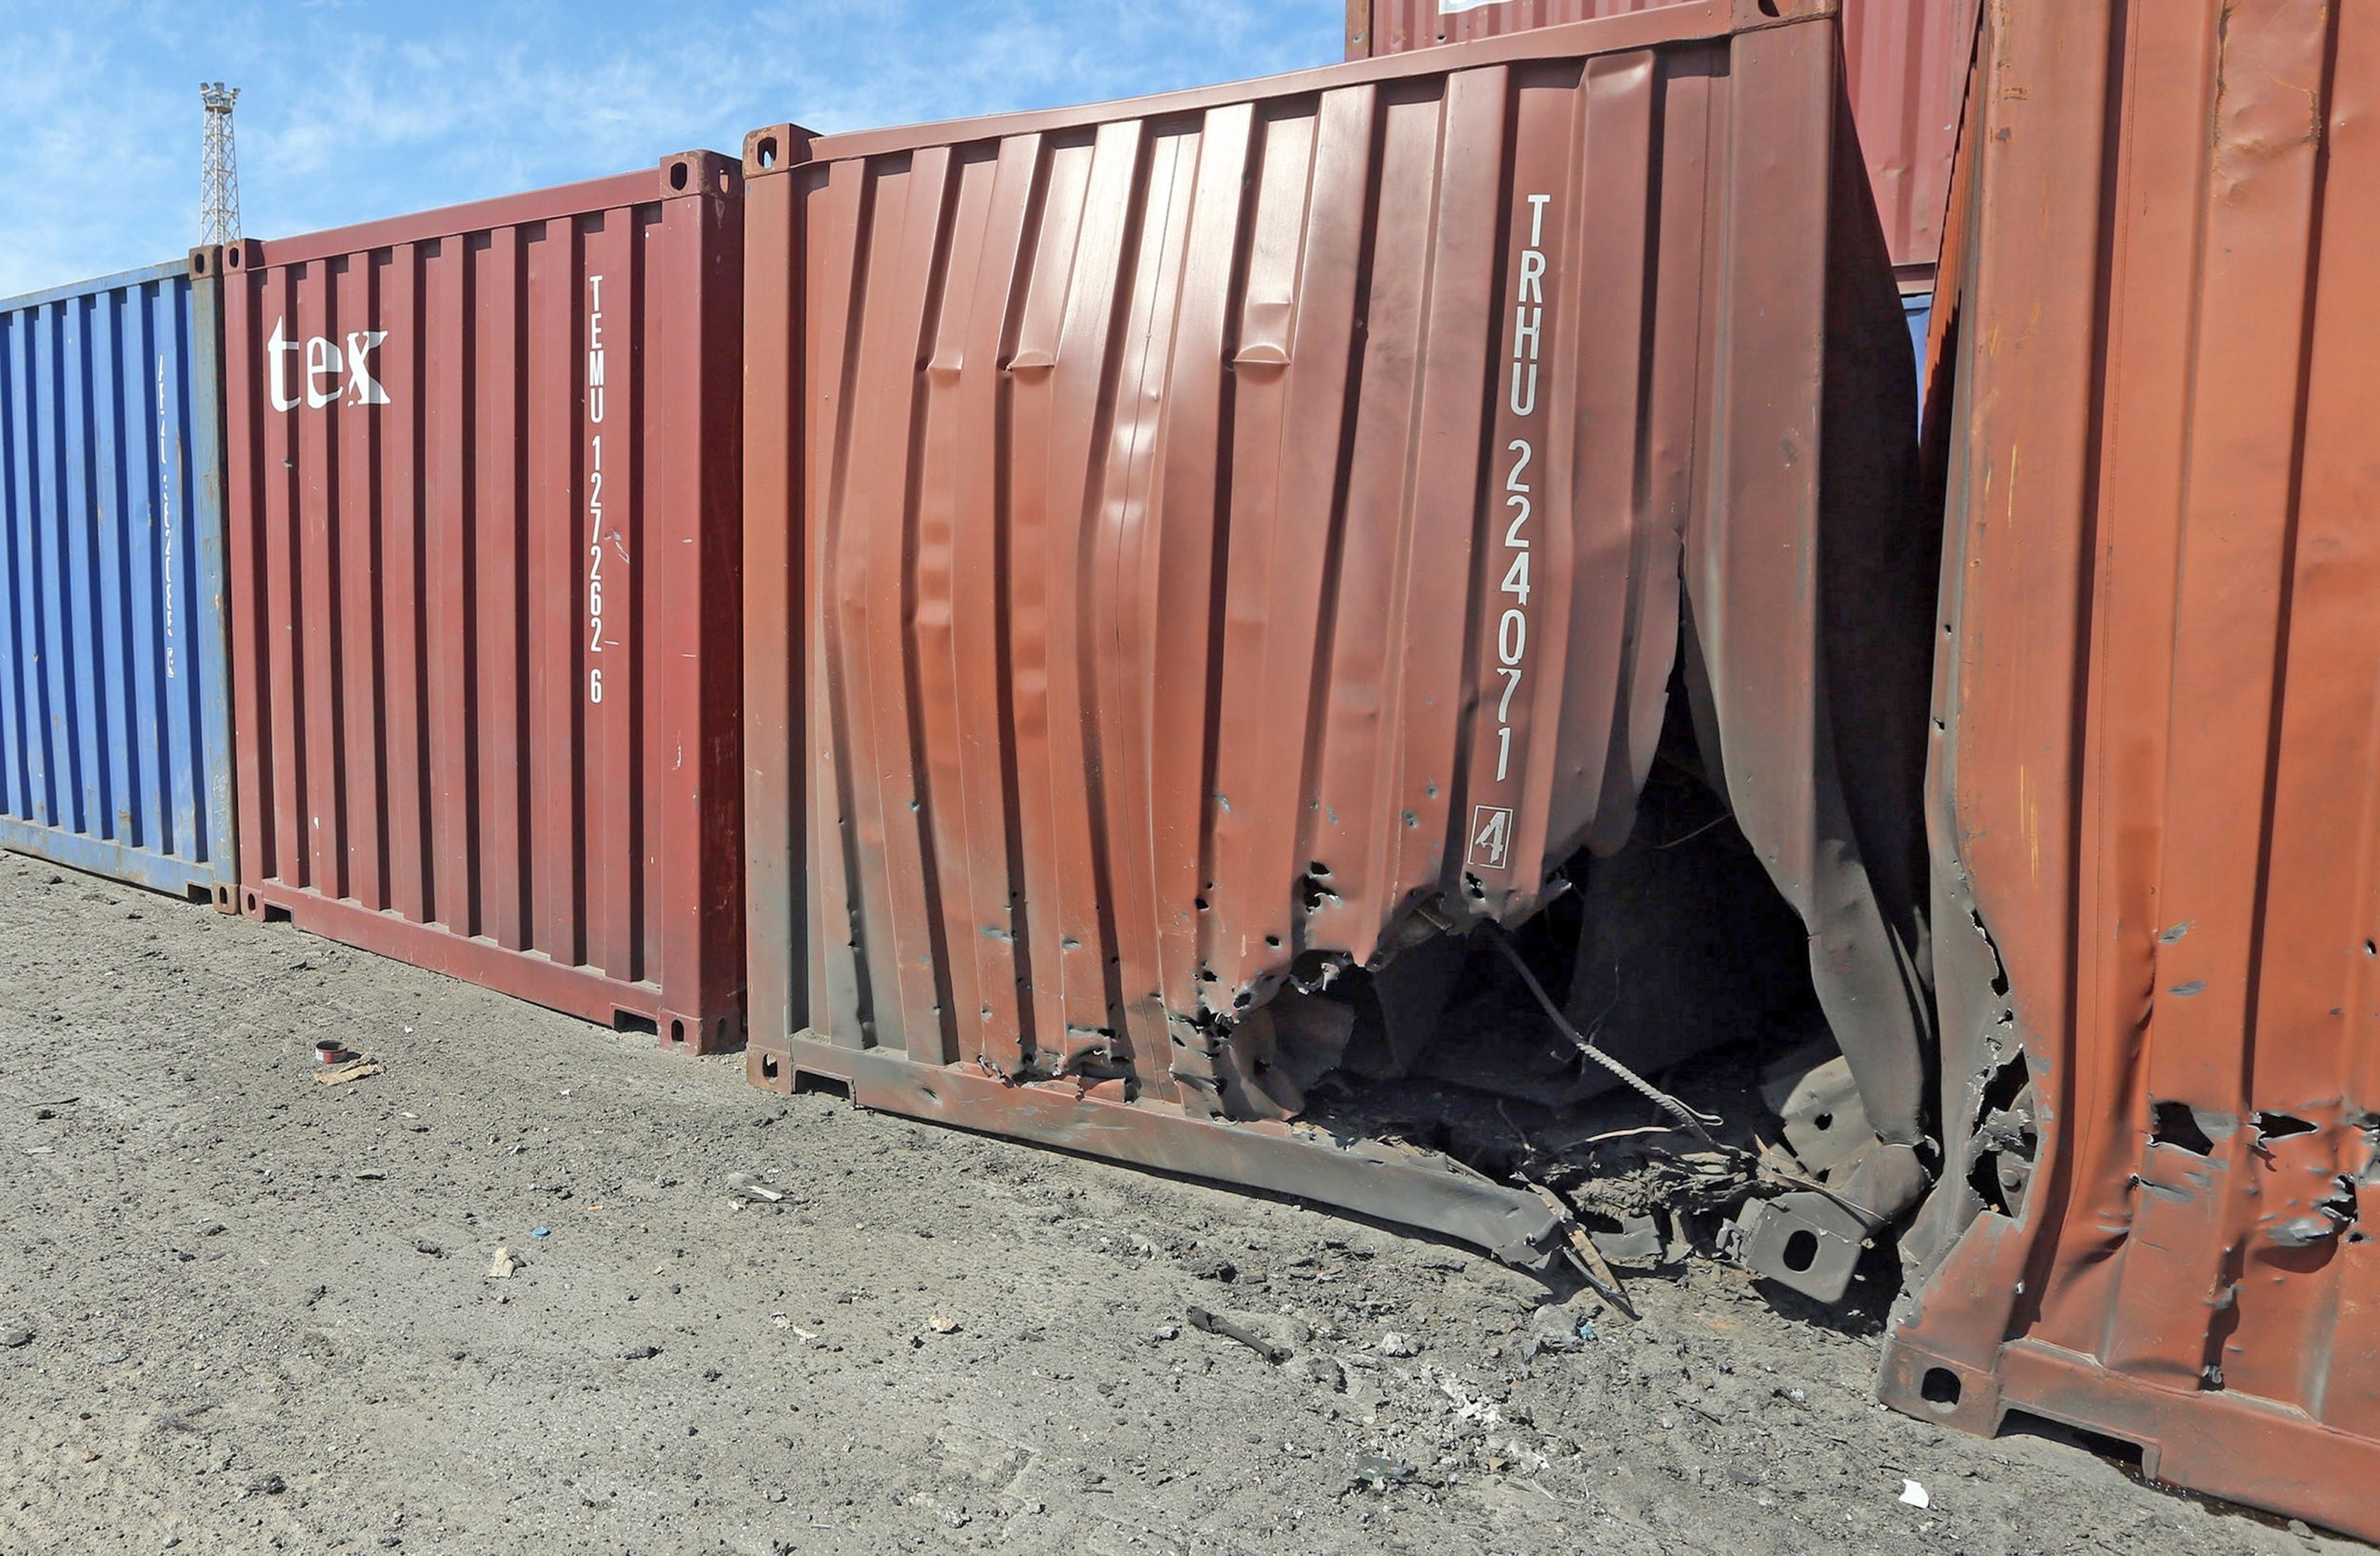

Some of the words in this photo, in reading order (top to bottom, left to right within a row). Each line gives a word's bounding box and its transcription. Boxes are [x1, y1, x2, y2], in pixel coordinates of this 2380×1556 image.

[267, 314, 391, 413] tex
[589, 274, 604, 424] TEMU
[1510, 193, 1552, 416] TRHU
[589, 434, 604, 653] 127262
[1497, 439, 1532, 782] 224071
[589, 668, 603, 704] 6
[1475, 810, 1506, 865] 4
